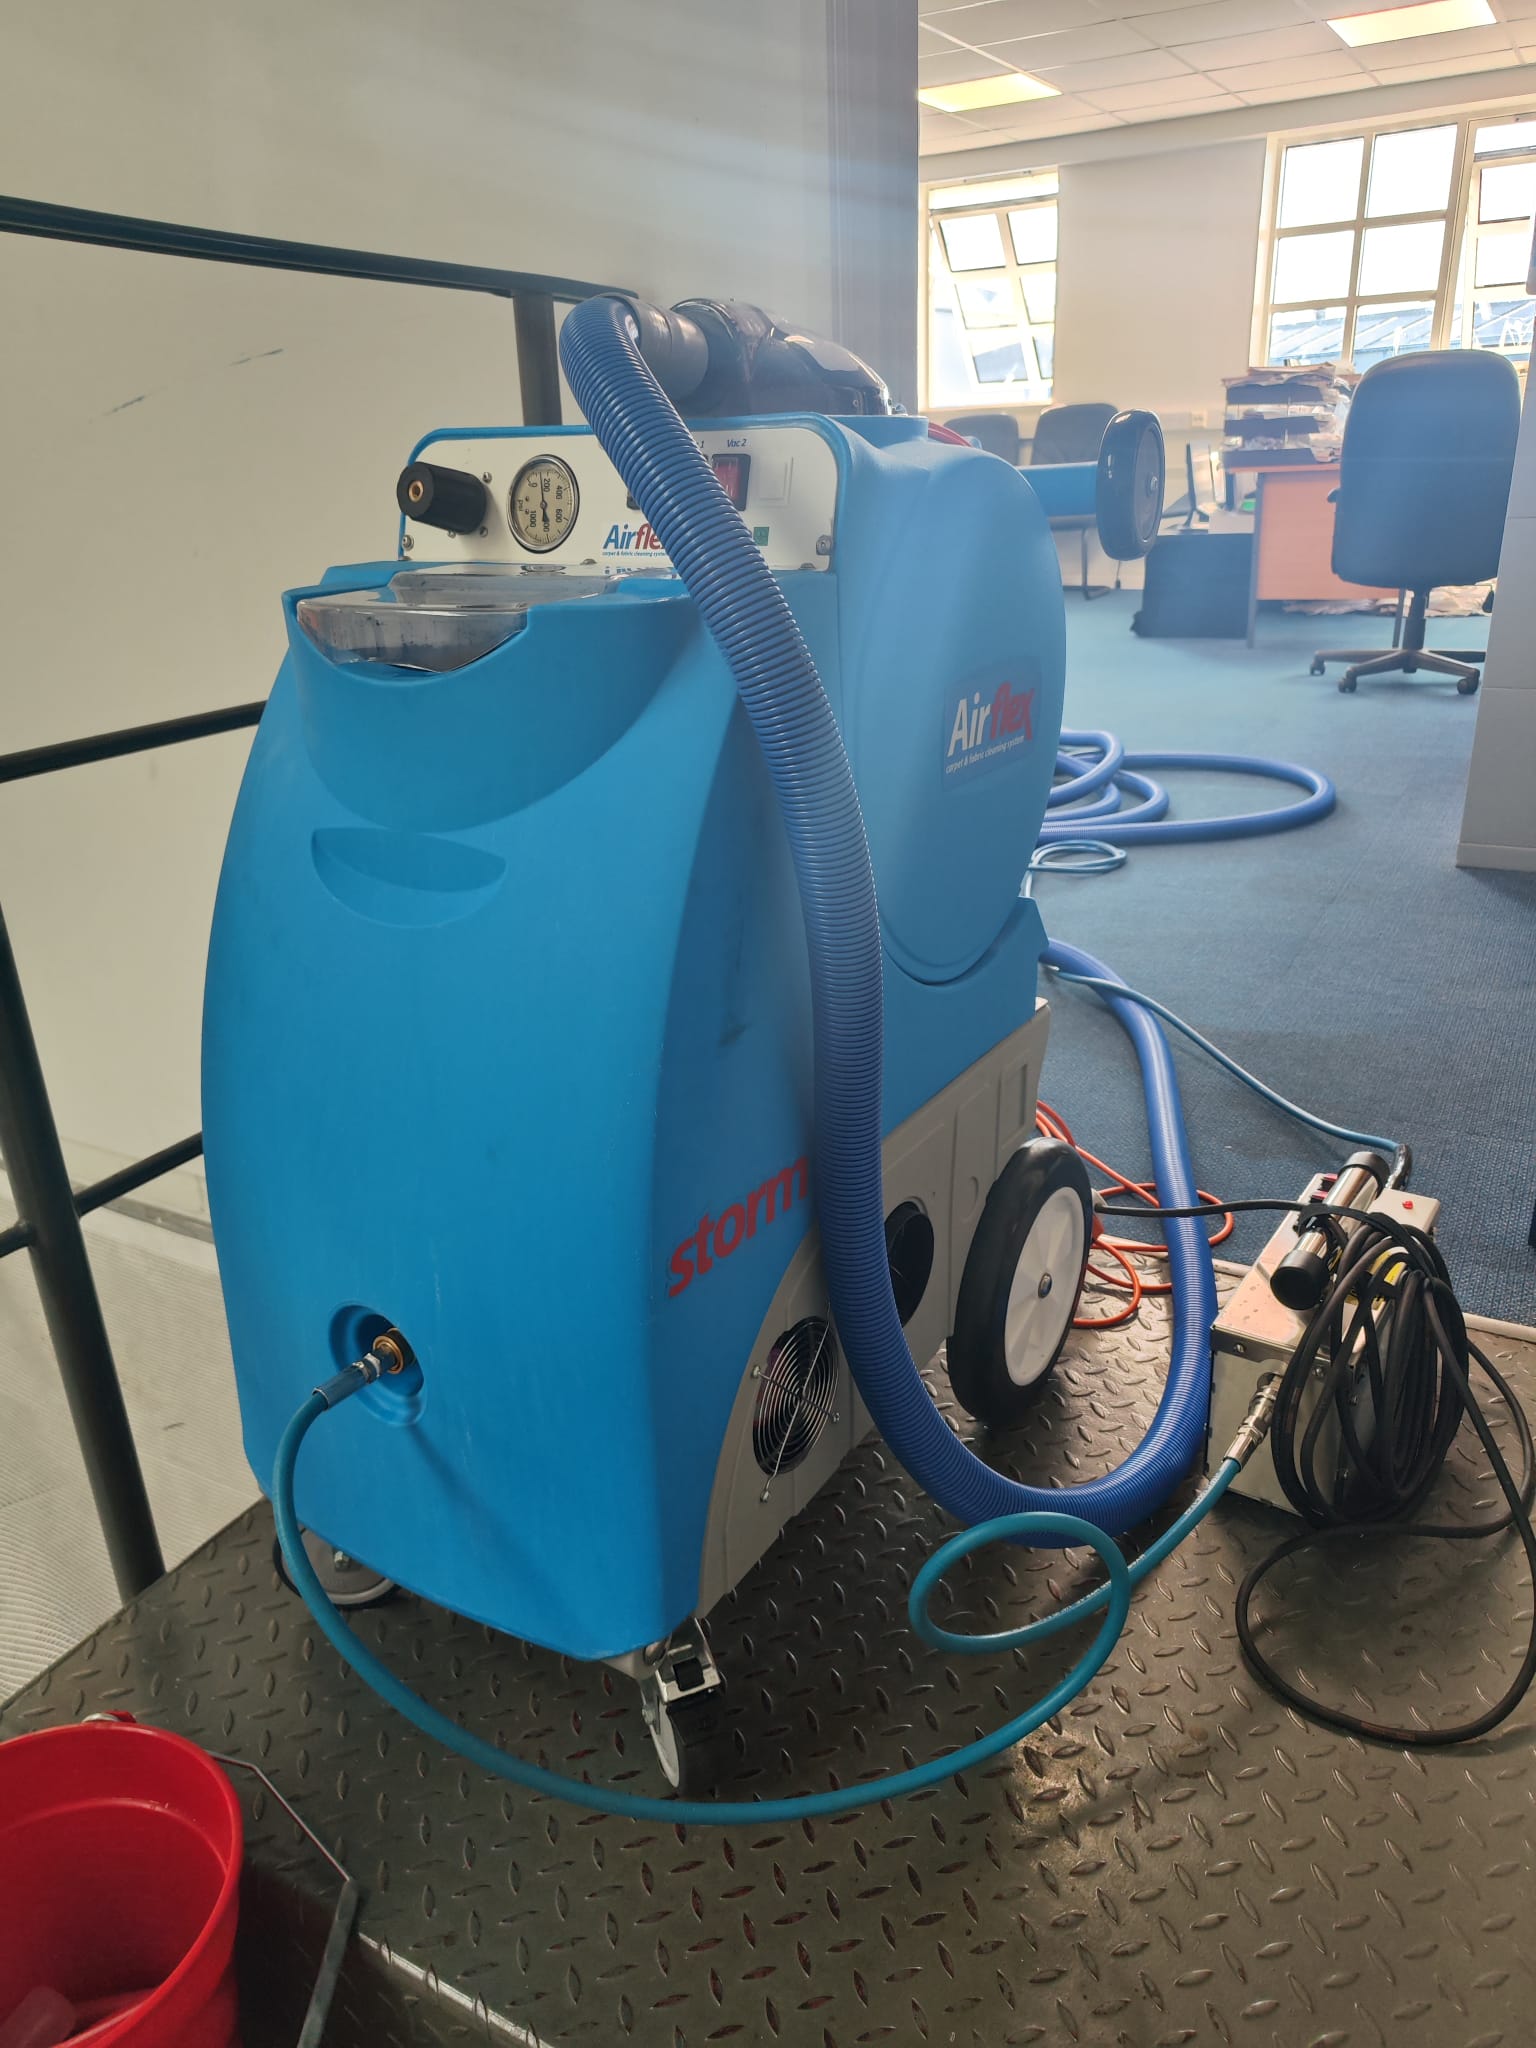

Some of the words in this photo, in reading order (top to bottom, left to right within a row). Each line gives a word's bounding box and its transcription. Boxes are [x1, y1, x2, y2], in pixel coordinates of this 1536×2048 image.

[727, 439, 740, 447] Vac
[741, 438, 747, 447] 2
[946, 682, 1035, 757] Airflex
[669, 1157, 808, 1298] storm
